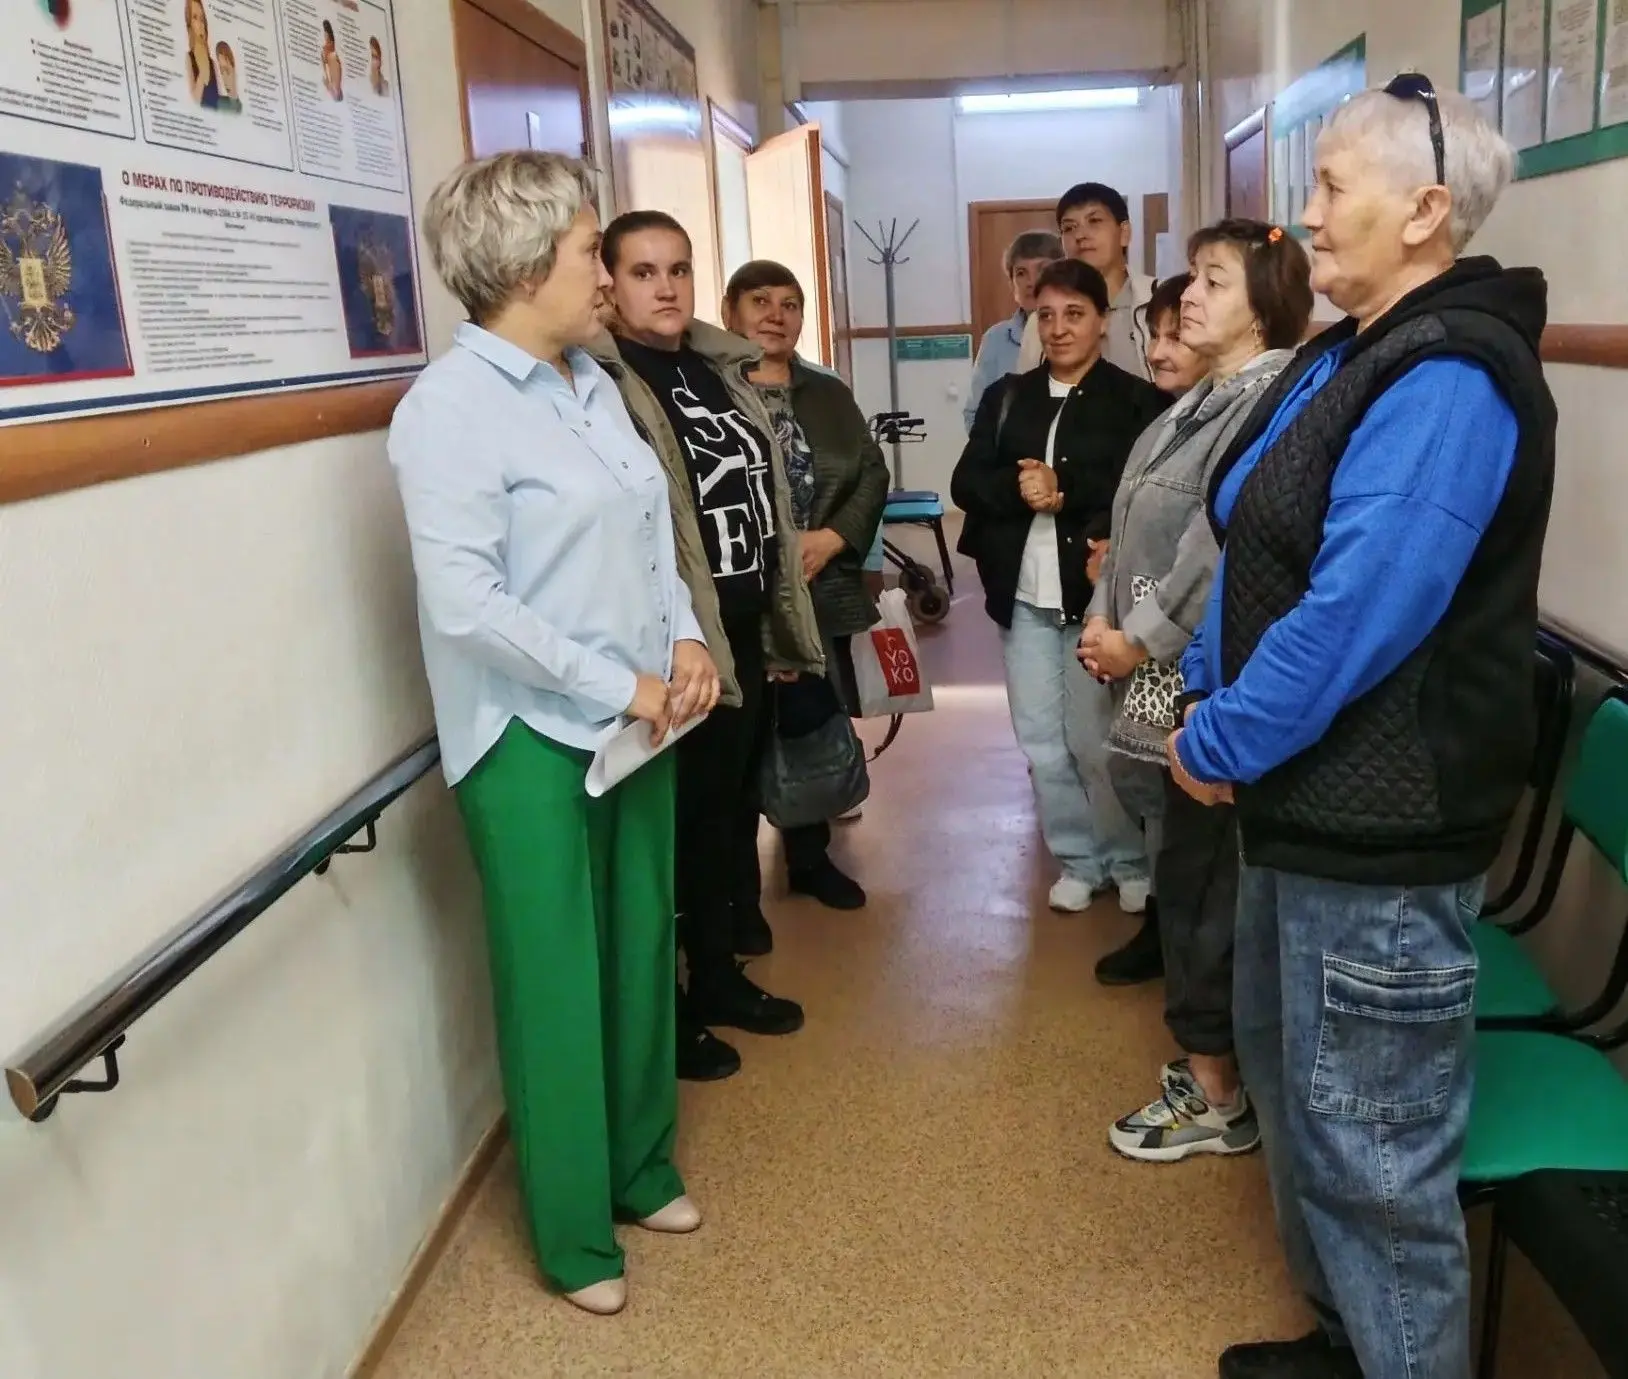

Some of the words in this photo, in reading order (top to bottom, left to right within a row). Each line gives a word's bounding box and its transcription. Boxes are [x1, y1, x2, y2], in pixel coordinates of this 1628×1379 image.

[121, 170, 130, 186] О
[132, 172, 168, 191] МЕРАХ
[169, 177, 183, 194] ПО
[185, 180, 269, 206] ПРОТИВОДЕЙСТВИЮ
[270, 194, 316, 213] ТЕРРОРИЗМУ
